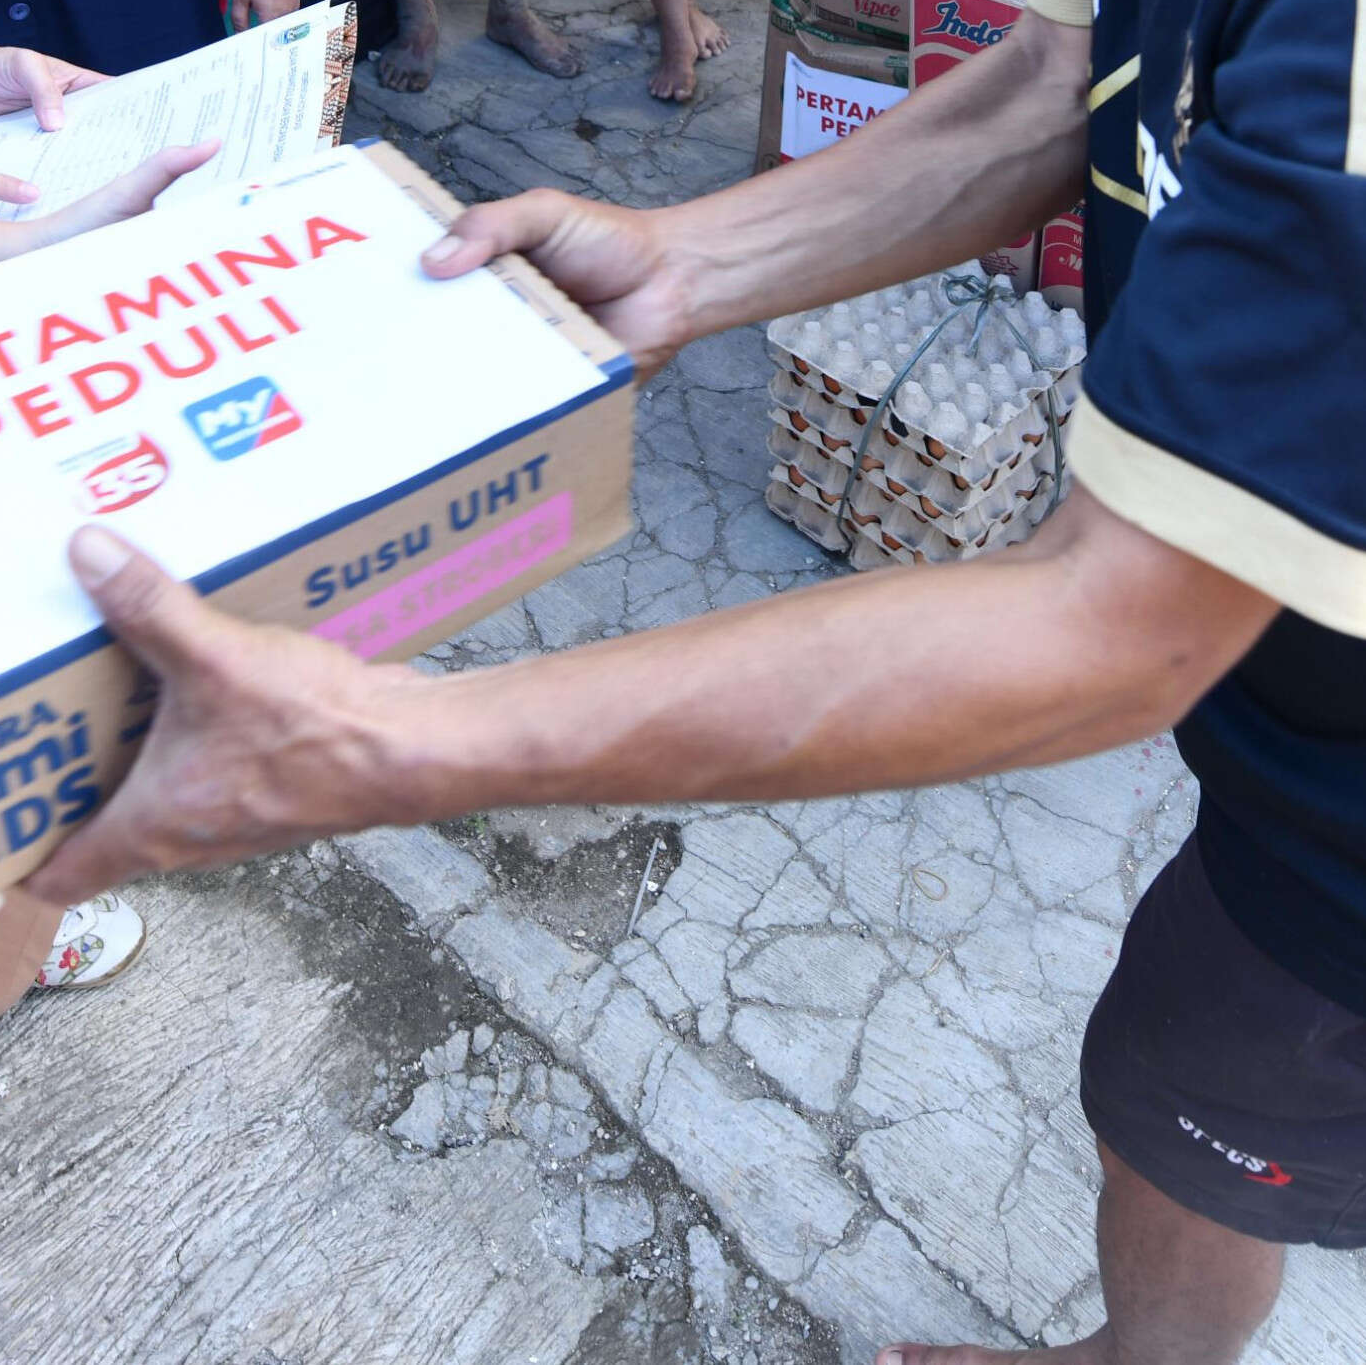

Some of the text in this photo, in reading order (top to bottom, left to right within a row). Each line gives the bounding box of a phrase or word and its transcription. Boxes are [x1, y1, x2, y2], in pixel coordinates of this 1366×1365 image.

[922, 0, 1012, 46] Indo
[796, 85, 887, 123] PERTAM
[305, 451, 552, 610] Susu UHT
